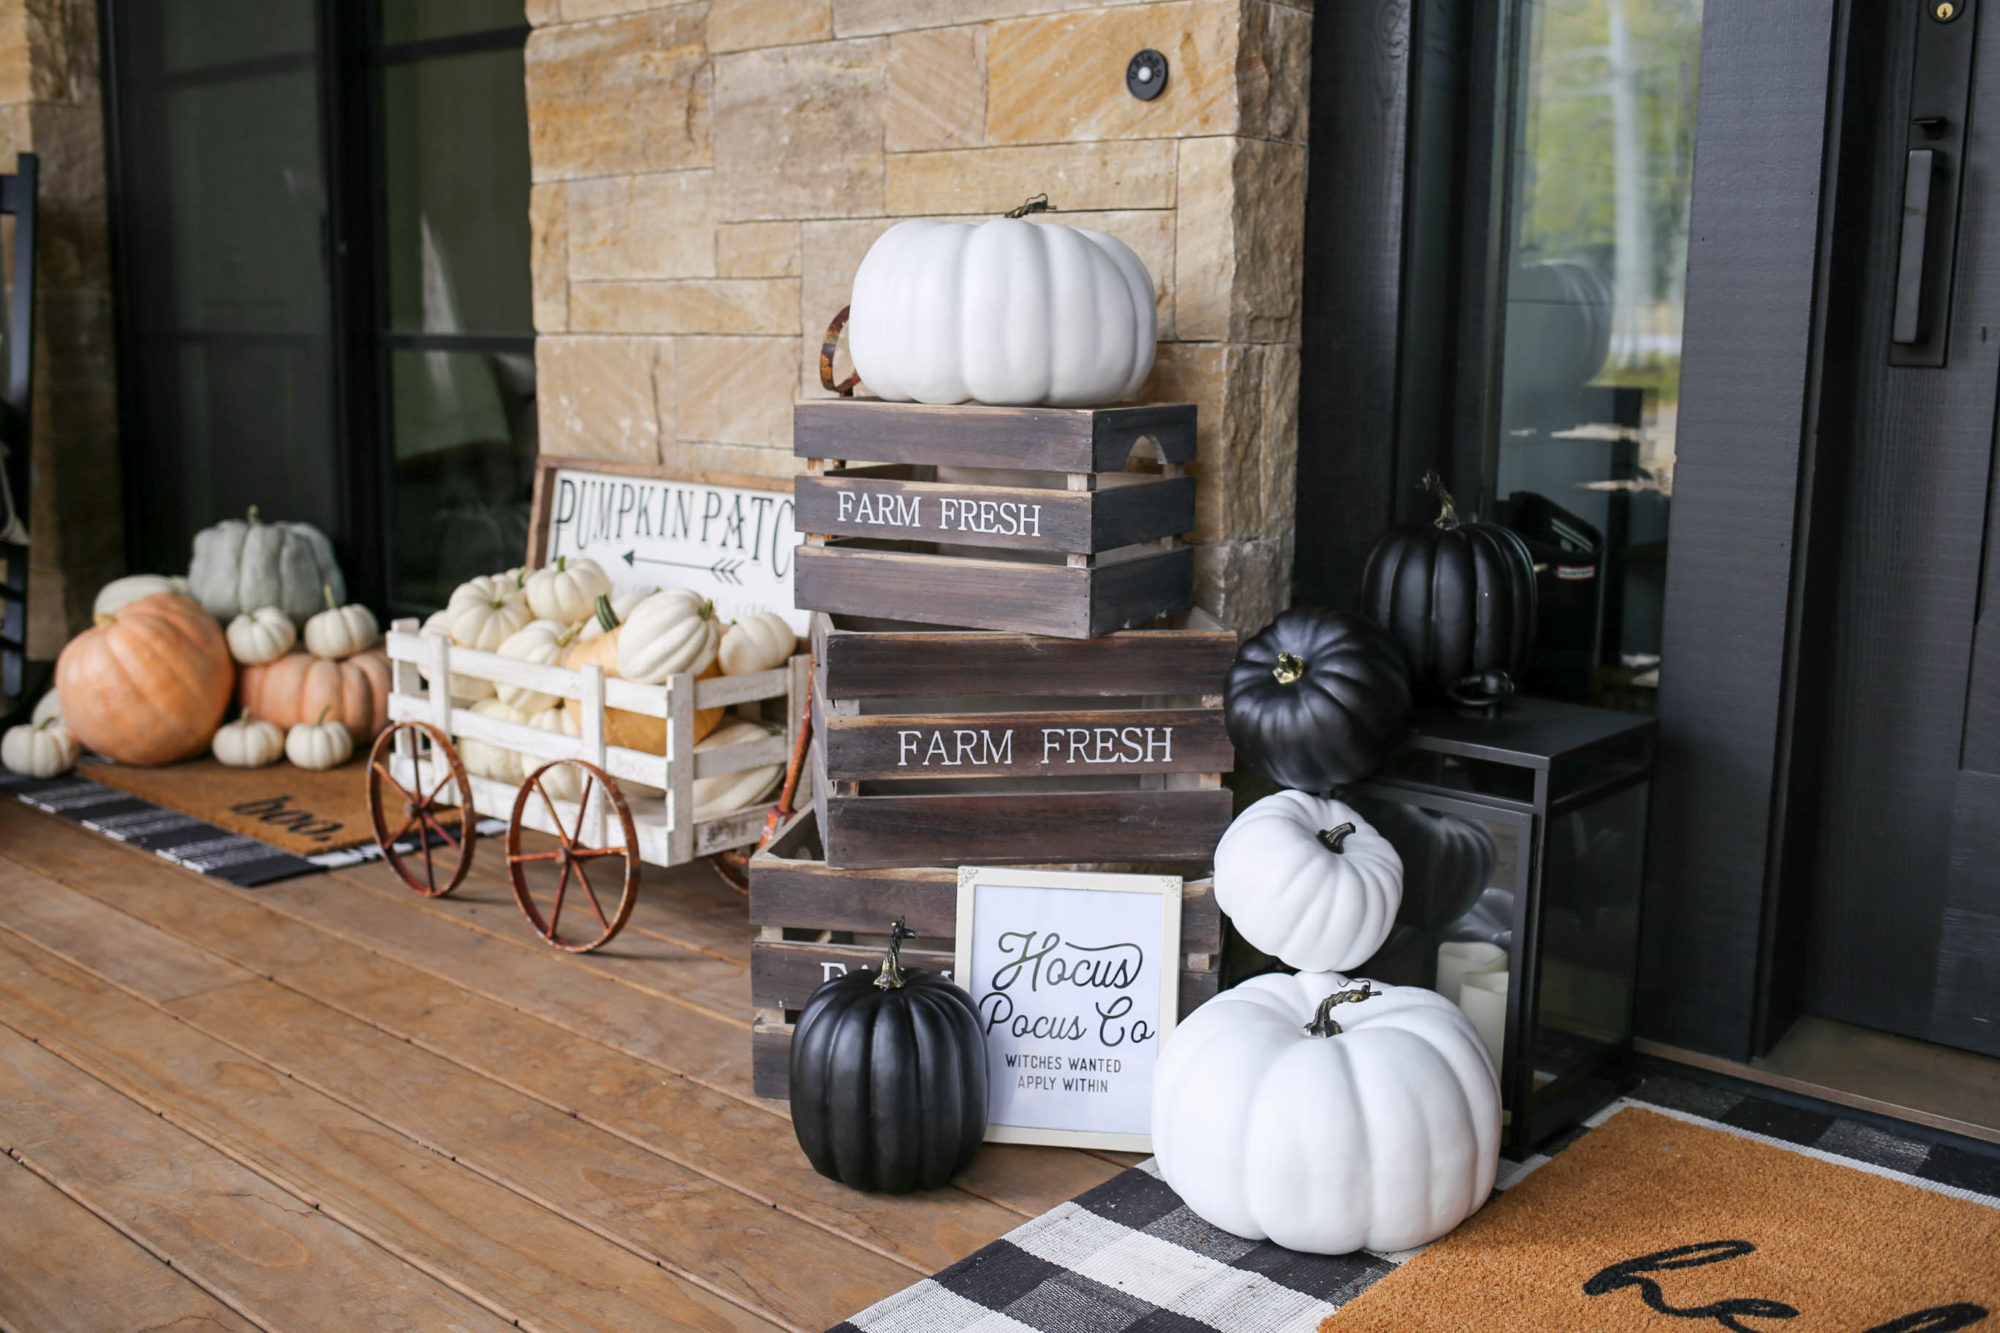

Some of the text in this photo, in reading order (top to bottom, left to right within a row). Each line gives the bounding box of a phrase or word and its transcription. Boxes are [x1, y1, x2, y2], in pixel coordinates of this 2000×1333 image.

[551, 478, 807, 579] PUMPKIN PATC
[837, 491, 1042, 538] FARM FRESH
[897, 727, 1174, 766] FARM FRESH
[991, 931, 1144, 992] Hocus
[978, 991, 1156, 1048] Pocus Co
[1005, 1053, 1122, 1074] WITCHES WANTED
[1017, 1075, 1108, 1093] APPLY WITHIN
